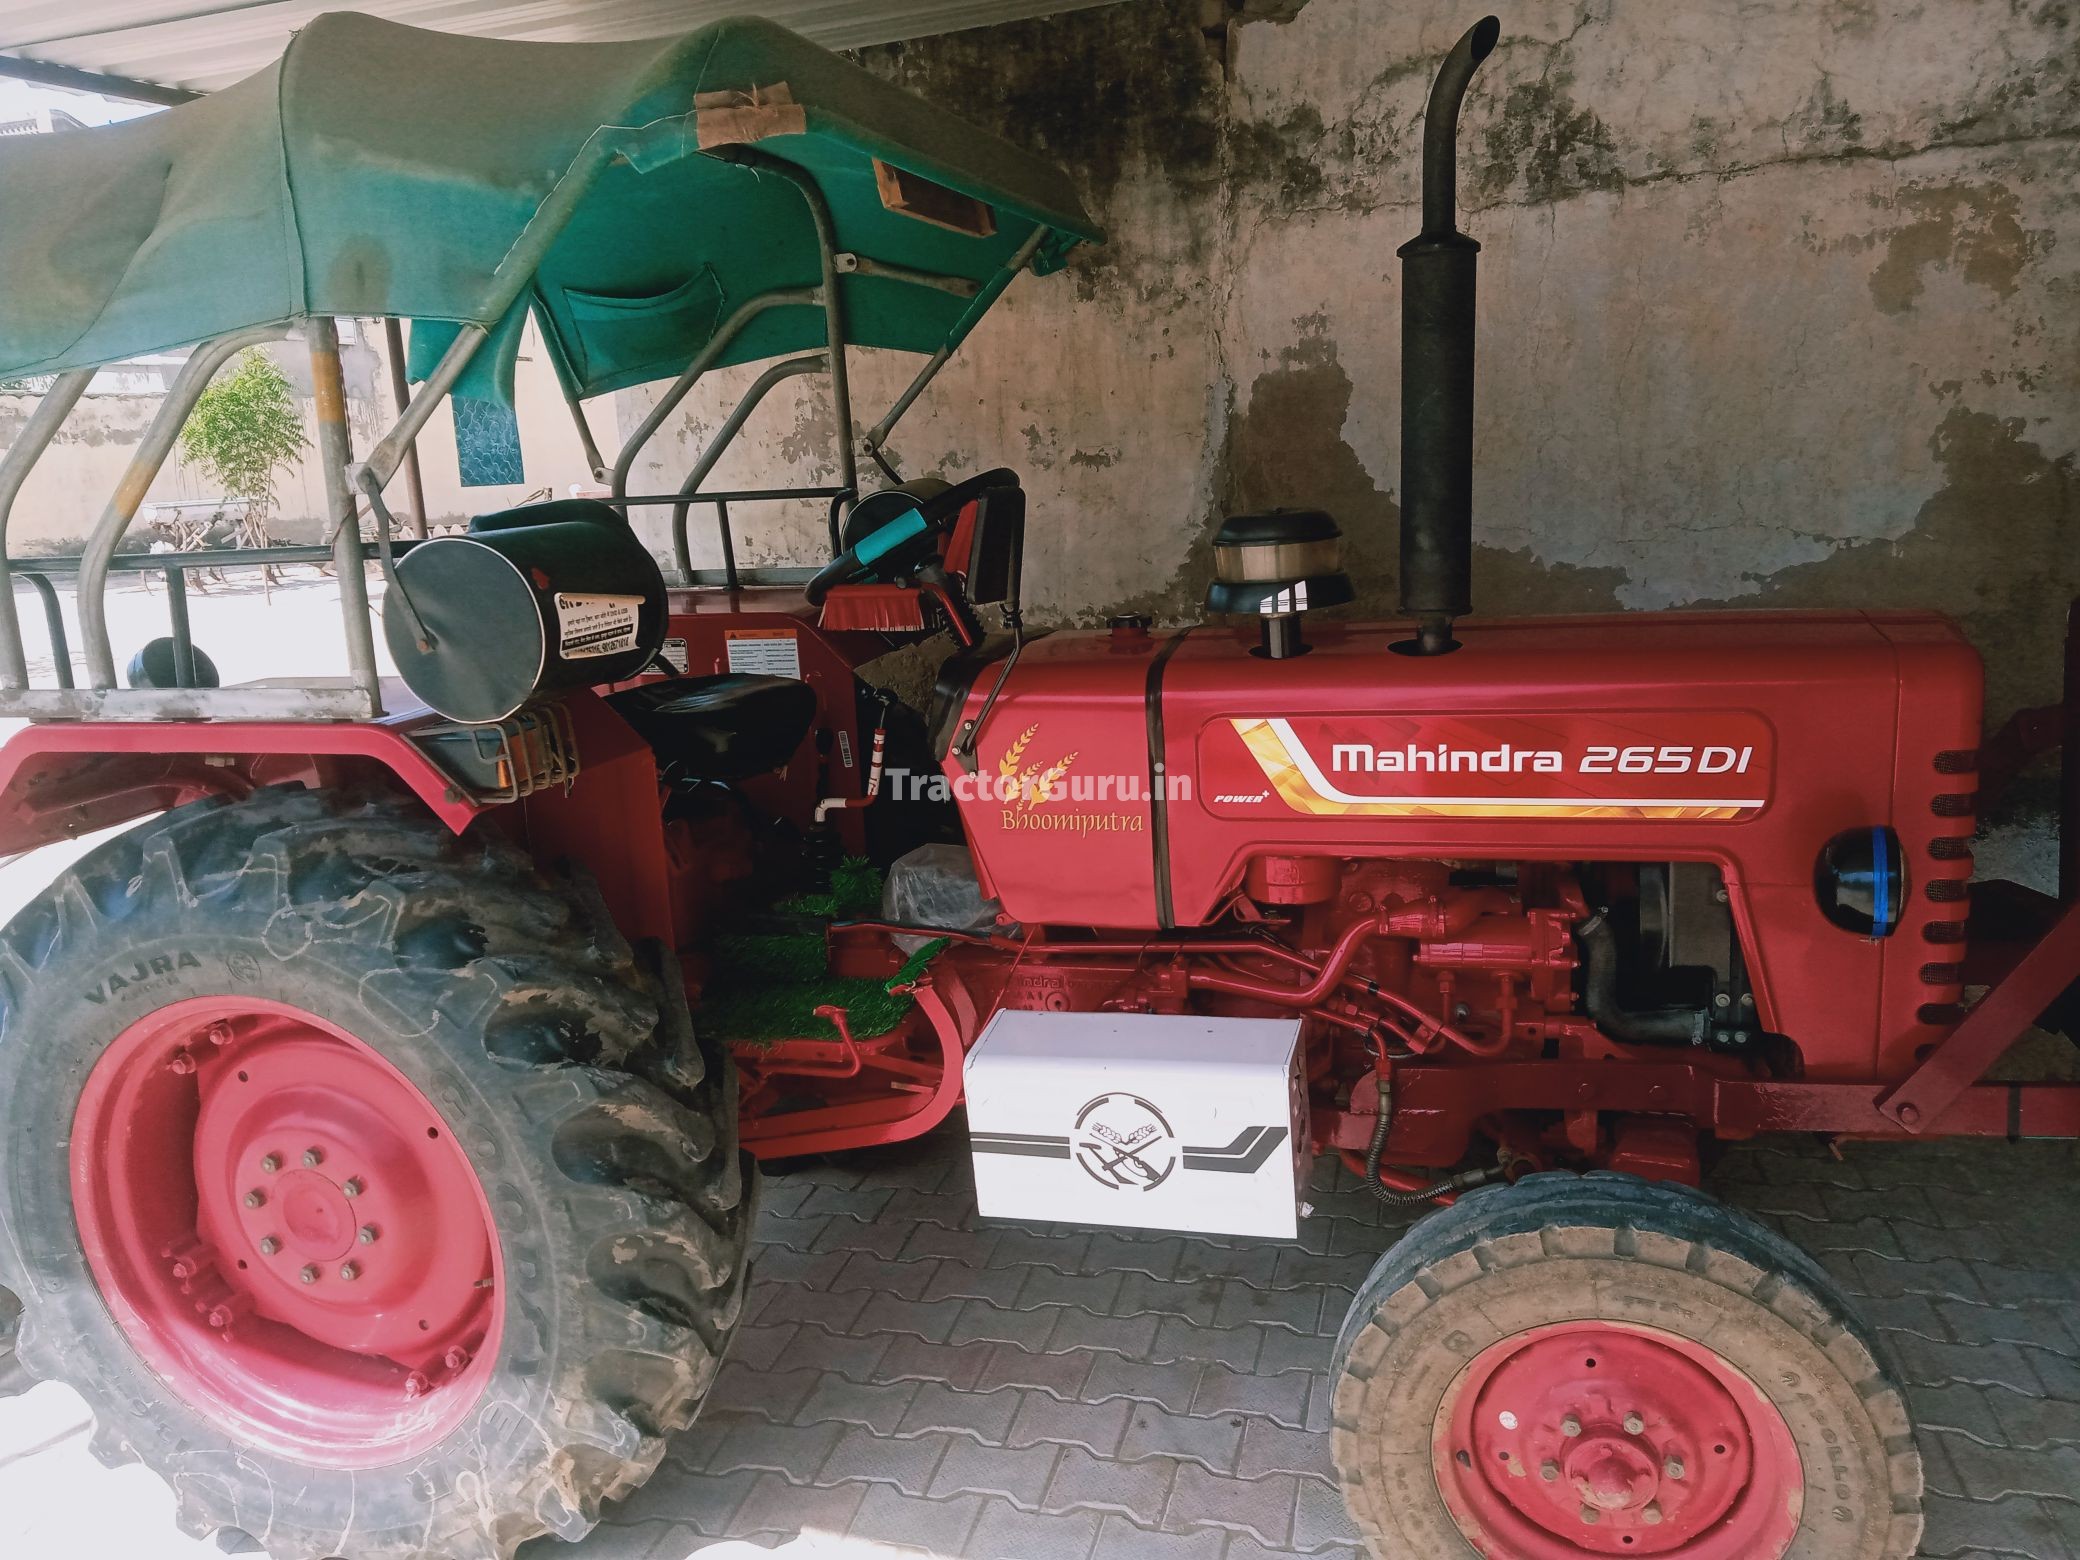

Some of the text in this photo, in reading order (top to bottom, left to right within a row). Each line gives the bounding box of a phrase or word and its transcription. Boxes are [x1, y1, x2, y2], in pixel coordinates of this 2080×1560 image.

[1333, 744, 1562, 772] Mahindra
[1001, 808, 1144, 838] Bhoomiputra
[84, 950, 202, 1004] VAJRA
